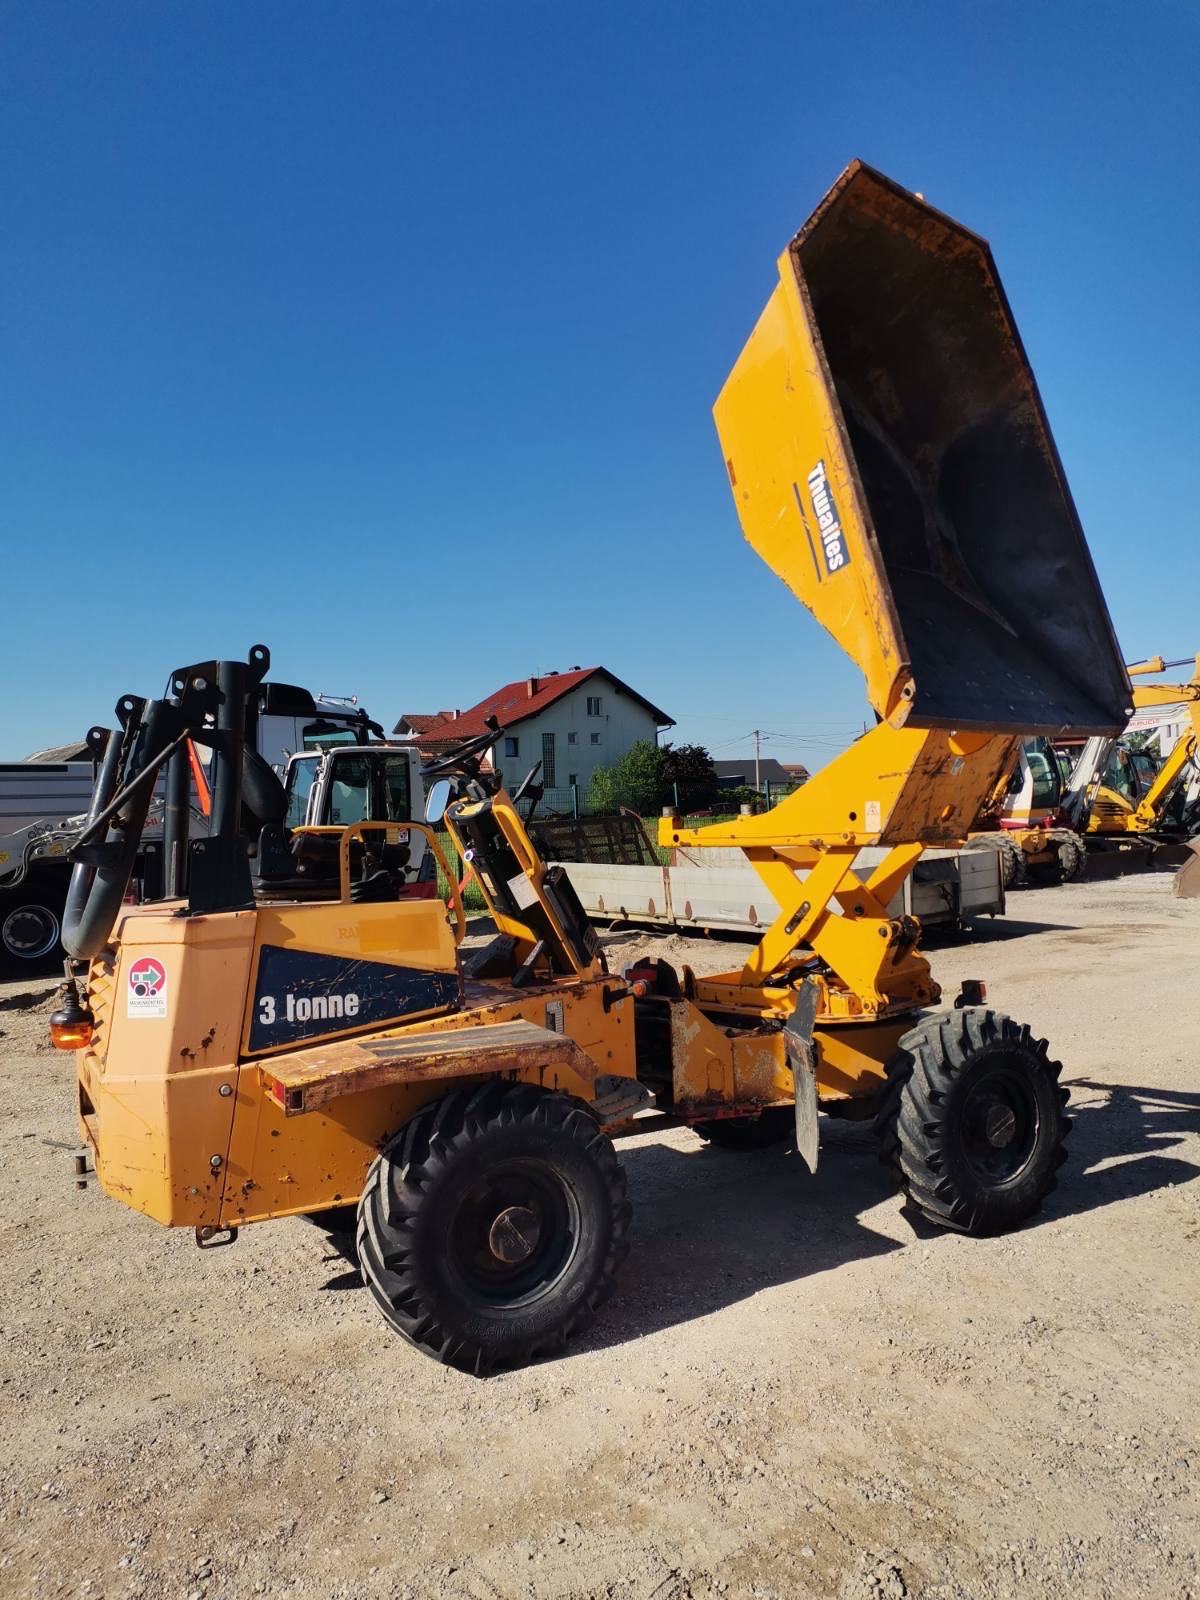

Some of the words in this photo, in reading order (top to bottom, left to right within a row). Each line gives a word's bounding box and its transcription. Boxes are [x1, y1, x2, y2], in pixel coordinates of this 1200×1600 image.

[808, 461, 844, 571] Thwaites
[259, 995, 276, 1025] 3
[286, 993, 359, 1022] tonne
